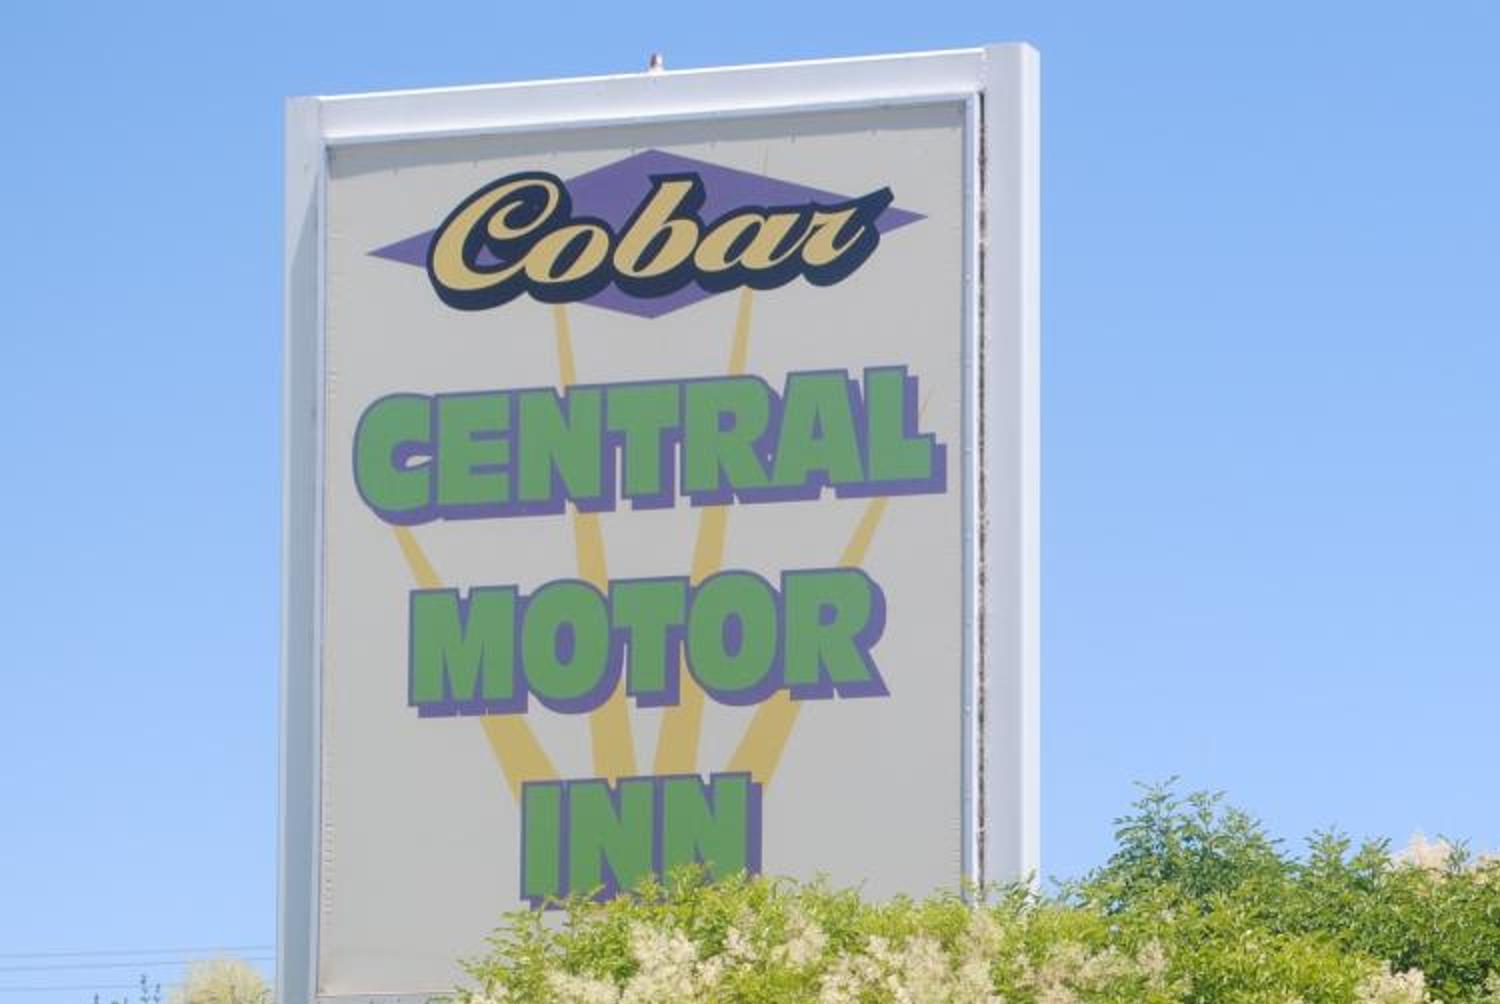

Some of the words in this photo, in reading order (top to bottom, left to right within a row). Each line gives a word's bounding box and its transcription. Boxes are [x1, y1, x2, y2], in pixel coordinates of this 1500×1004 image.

[426, 172, 894, 311] Cobar
[352, 365, 947, 526] CENTRAL
[408, 567, 890, 718] MOTOR
[520, 771, 762, 910] INN
